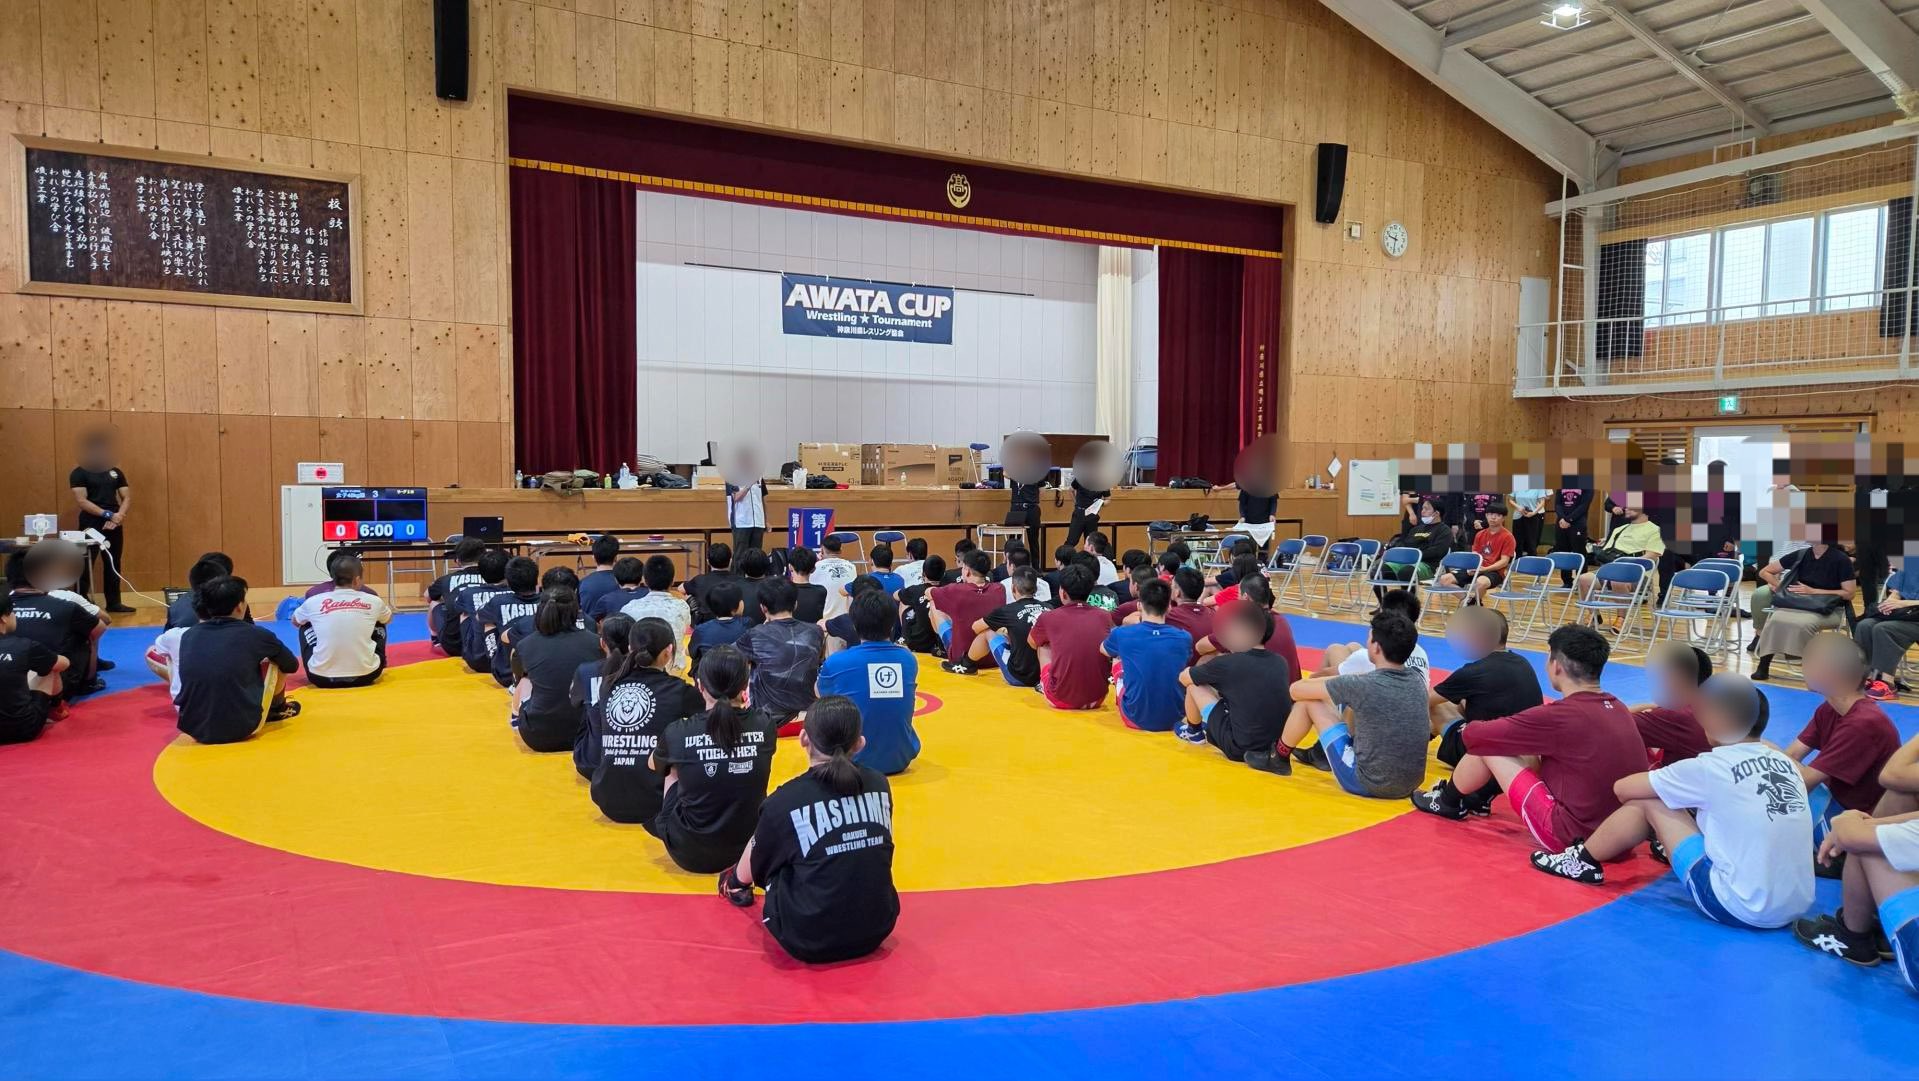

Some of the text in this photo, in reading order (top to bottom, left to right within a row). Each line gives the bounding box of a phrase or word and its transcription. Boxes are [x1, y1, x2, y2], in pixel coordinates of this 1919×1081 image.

[328, 198, 344, 230] 校歌
[785, 283, 951, 318] AWATA CUP
[806, 309, 932, 328] Wrestling Tournament
[837, 325, 904, 338] 神奈川県レスリング協会
[372, 490, 379, 498] 3
[336, 523, 346, 537] 0
[360, 523, 394, 537] 6:00
[405, 523, 415, 536] 0
[14, 610, 51, 620] ARIYA
[880, 671, 893, 682] げ
[602, 734, 658, 748] WRESTLING
[613, 757, 635, 766] JAPAN
[790, 791, 893, 858] KASHIMA
[841, 828, 868, 842] GAKUEN
[825, 835, 884, 856] WRESTLING TEAM
